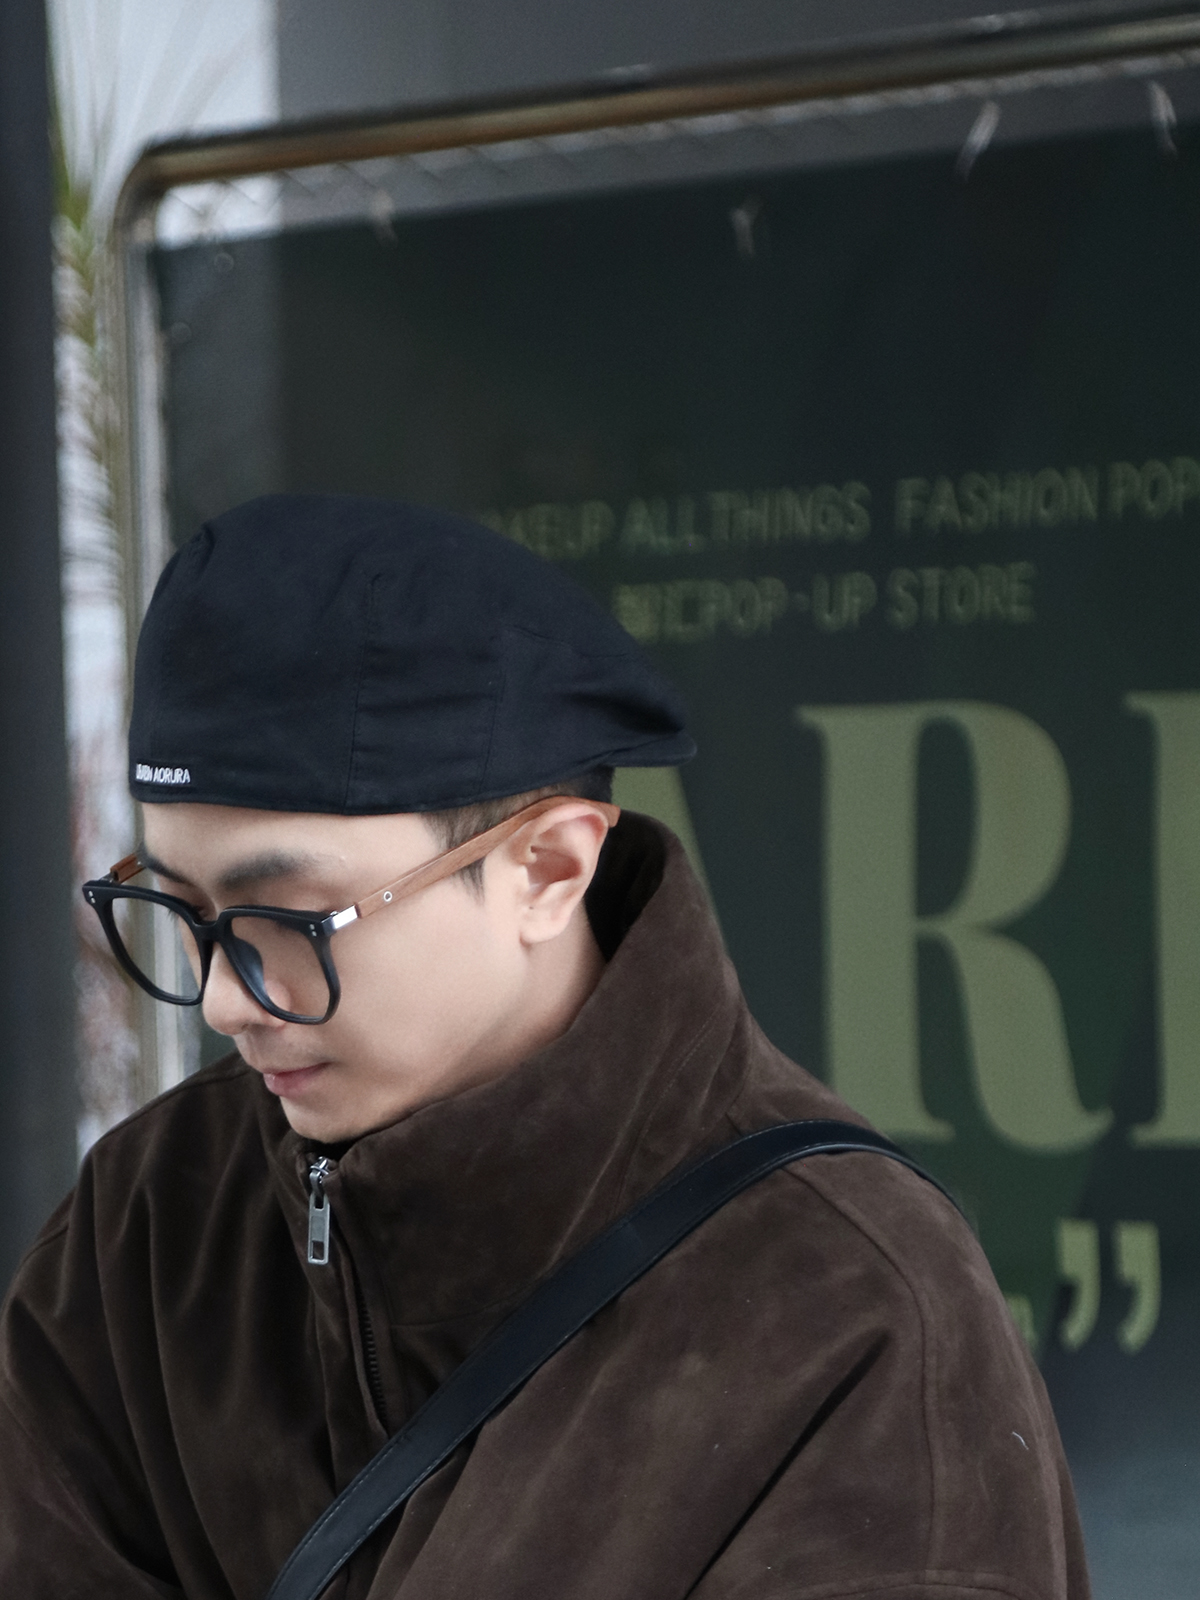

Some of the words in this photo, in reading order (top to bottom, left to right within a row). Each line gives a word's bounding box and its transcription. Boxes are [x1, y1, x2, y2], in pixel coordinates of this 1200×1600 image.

[706, 478, 872, 547] THINGS
[894, 464, 1099, 537] FASHION
[884, 560, 1038, 631] STORE
